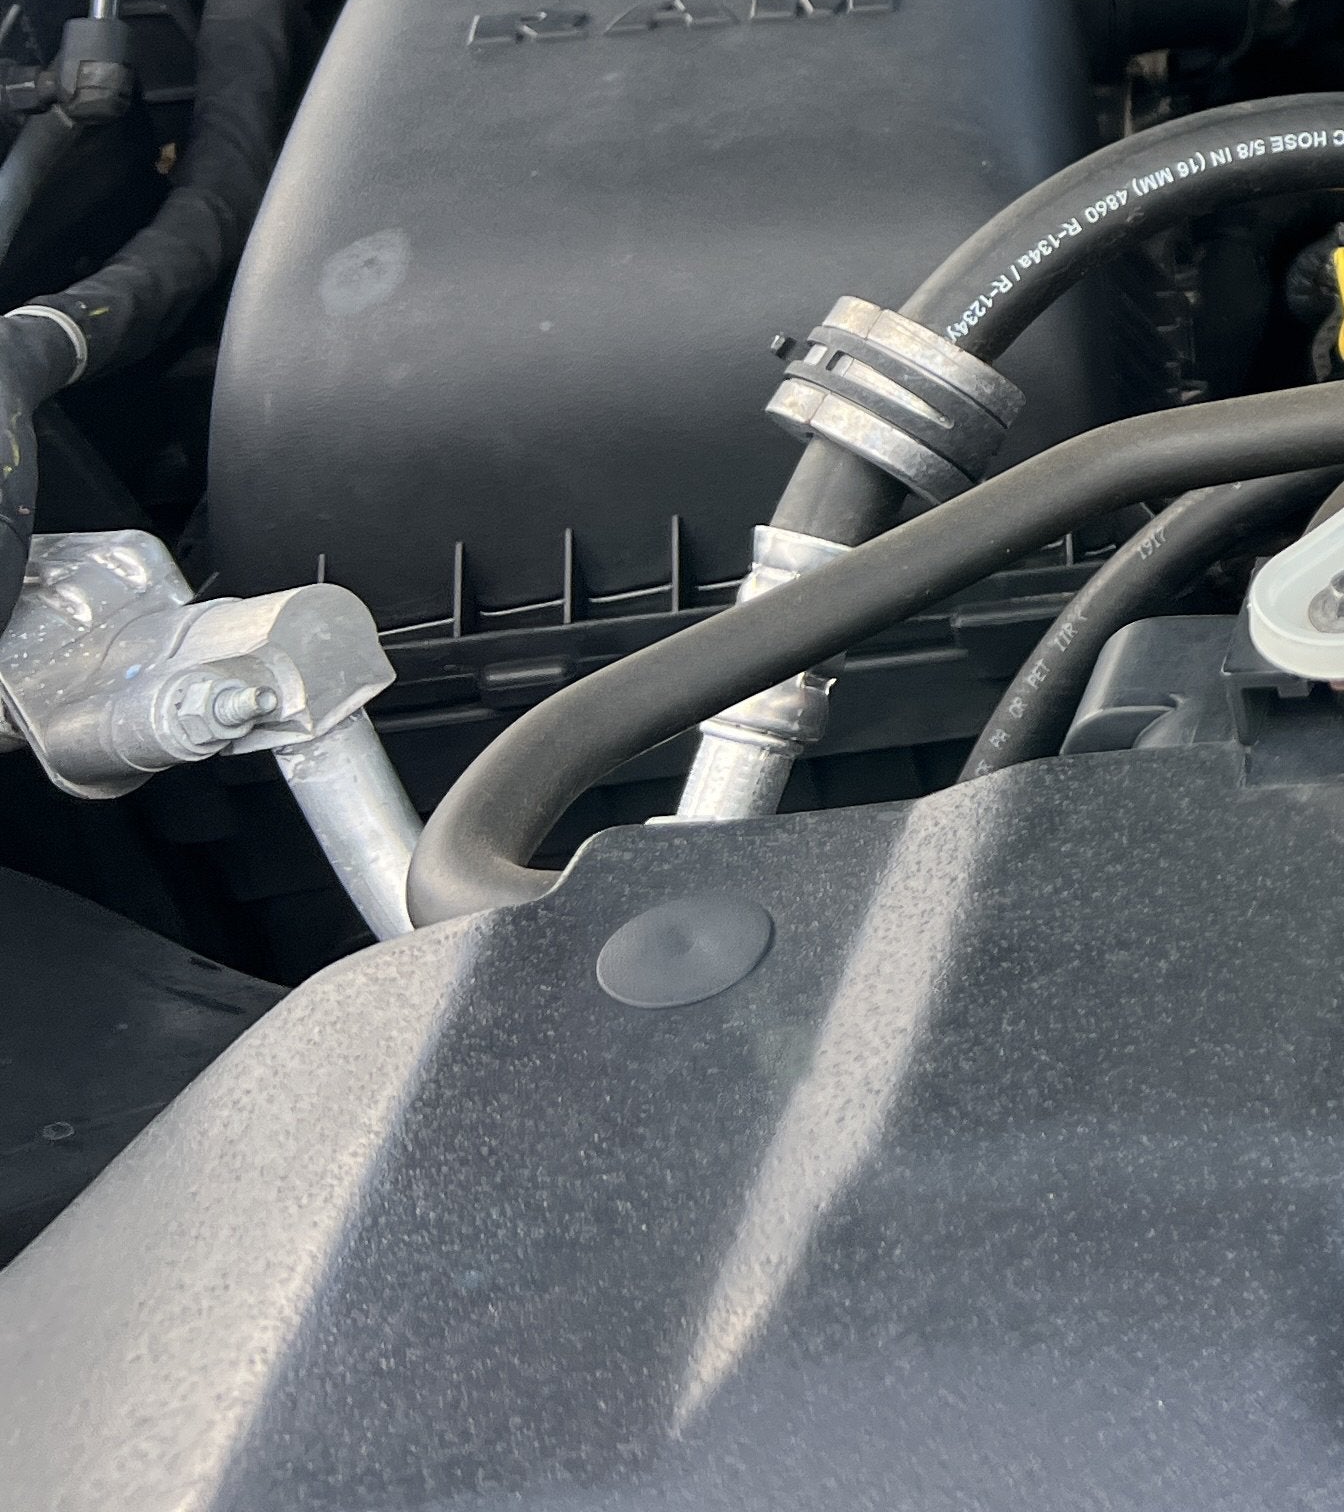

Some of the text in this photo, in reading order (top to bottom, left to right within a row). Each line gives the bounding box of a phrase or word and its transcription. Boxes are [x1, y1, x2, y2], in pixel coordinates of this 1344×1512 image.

[1236, 139, 1266, 160] 5/8
[1270, 129, 1327, 153] HOSE
[1176, 152, 1206, 178] (16
[1209, 147, 1233, 167] IN
[1131, 167, 1175, 197] MM)
[1084, 189, 1128, 224] 4860
[1017, 217, 1083, 268] R-134a
[946, 274, 1014, 344] R-1234y
